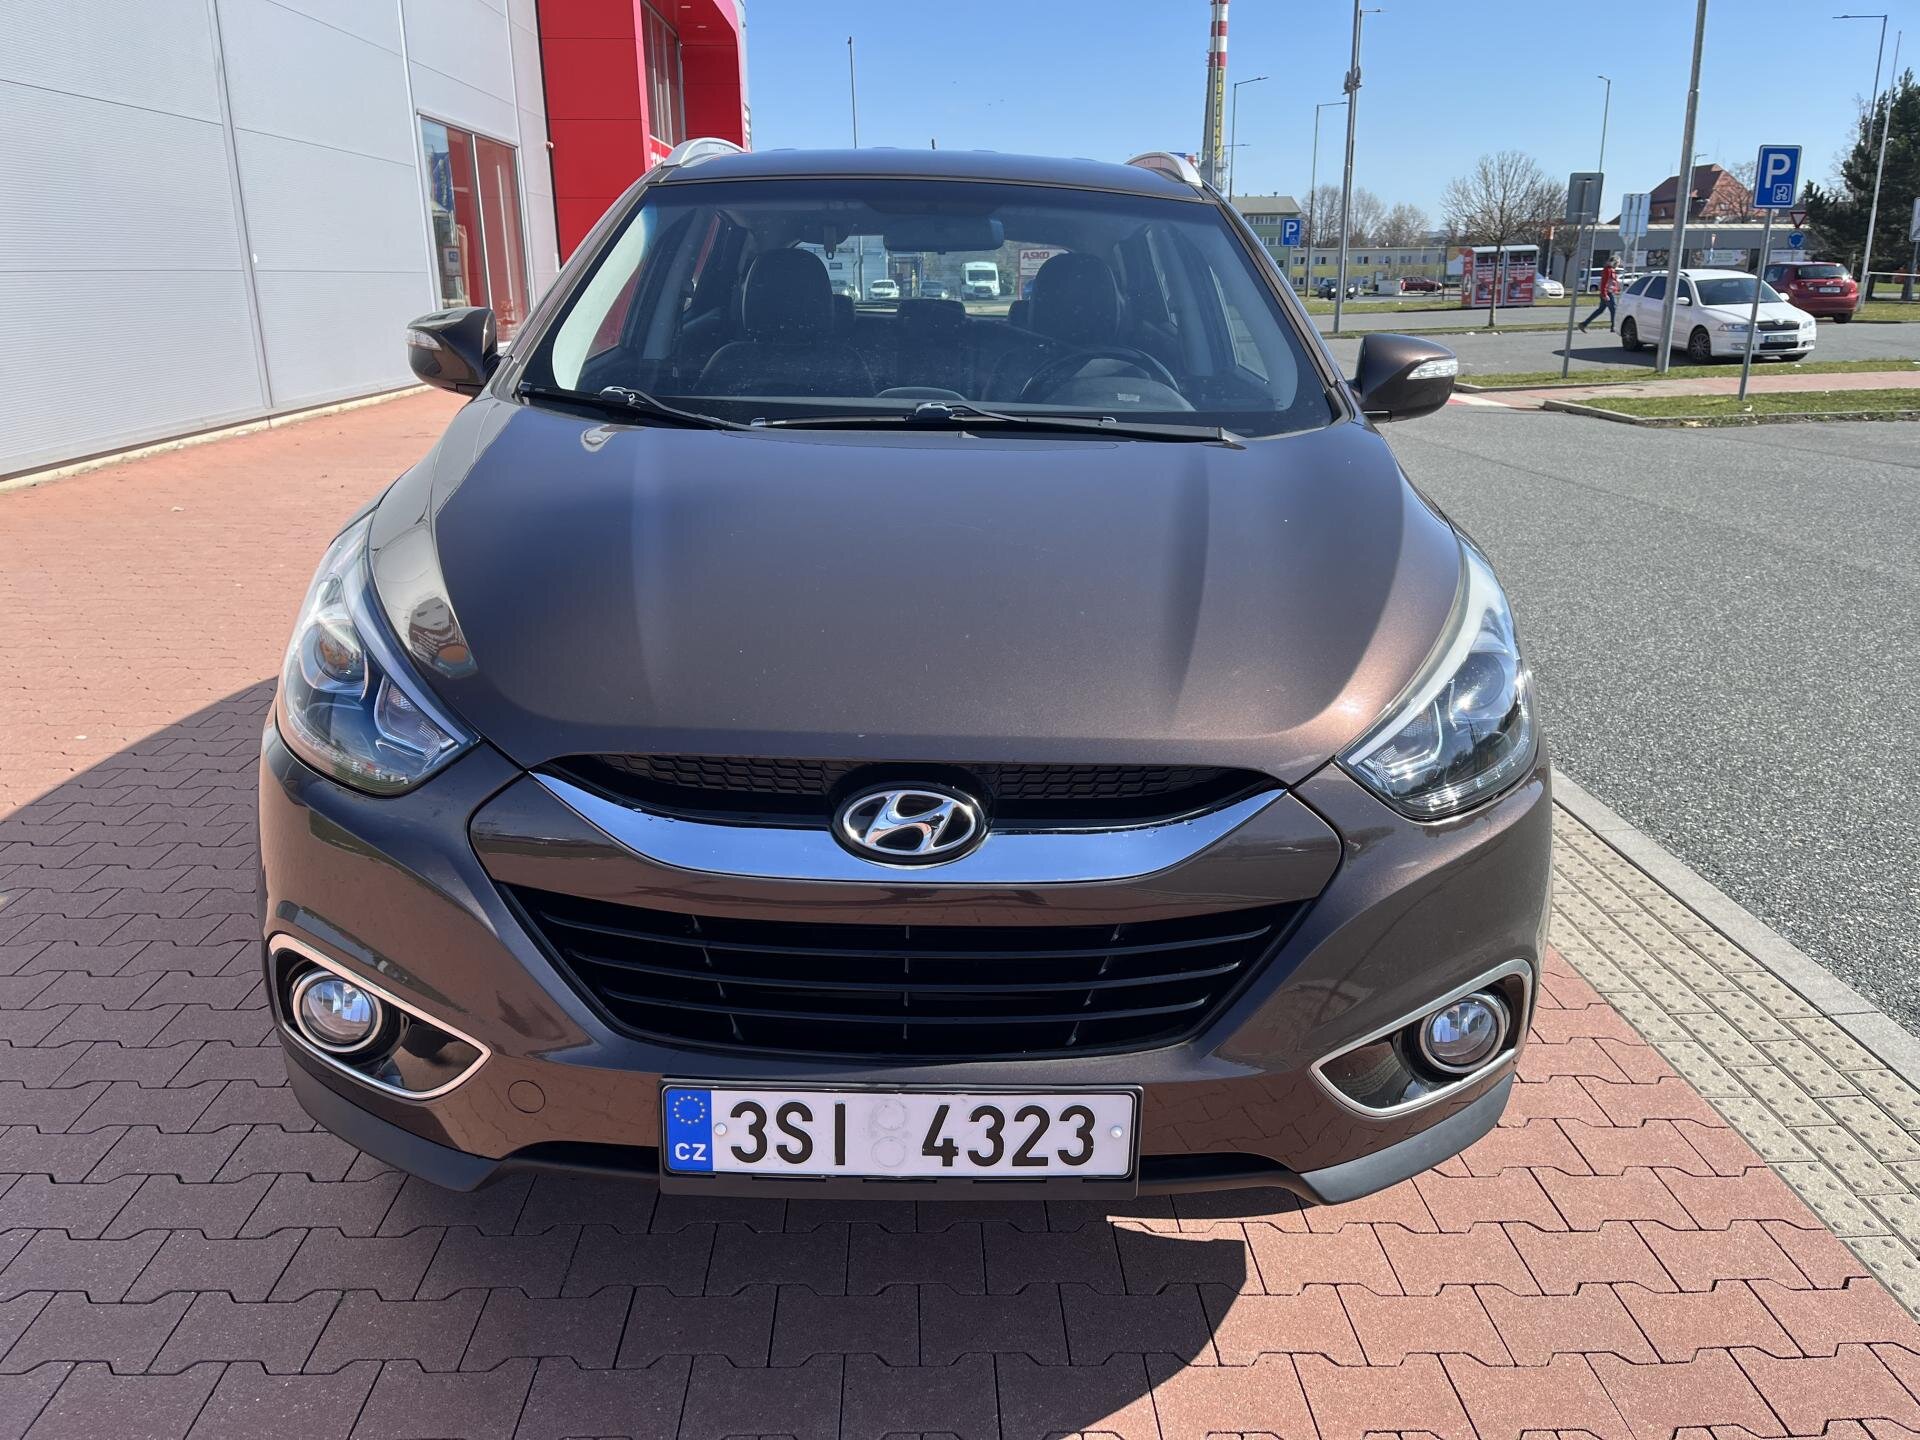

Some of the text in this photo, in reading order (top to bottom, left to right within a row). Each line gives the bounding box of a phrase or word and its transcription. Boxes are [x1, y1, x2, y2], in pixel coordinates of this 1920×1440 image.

[1764, 153, 1792, 189] P
[1285, 221, 1299, 238] P
[1022, 251, 1050, 260] ASKO
[729, 1100, 1096, 1168] 3SI 4323
[674, 1142, 707, 1162] CZ
